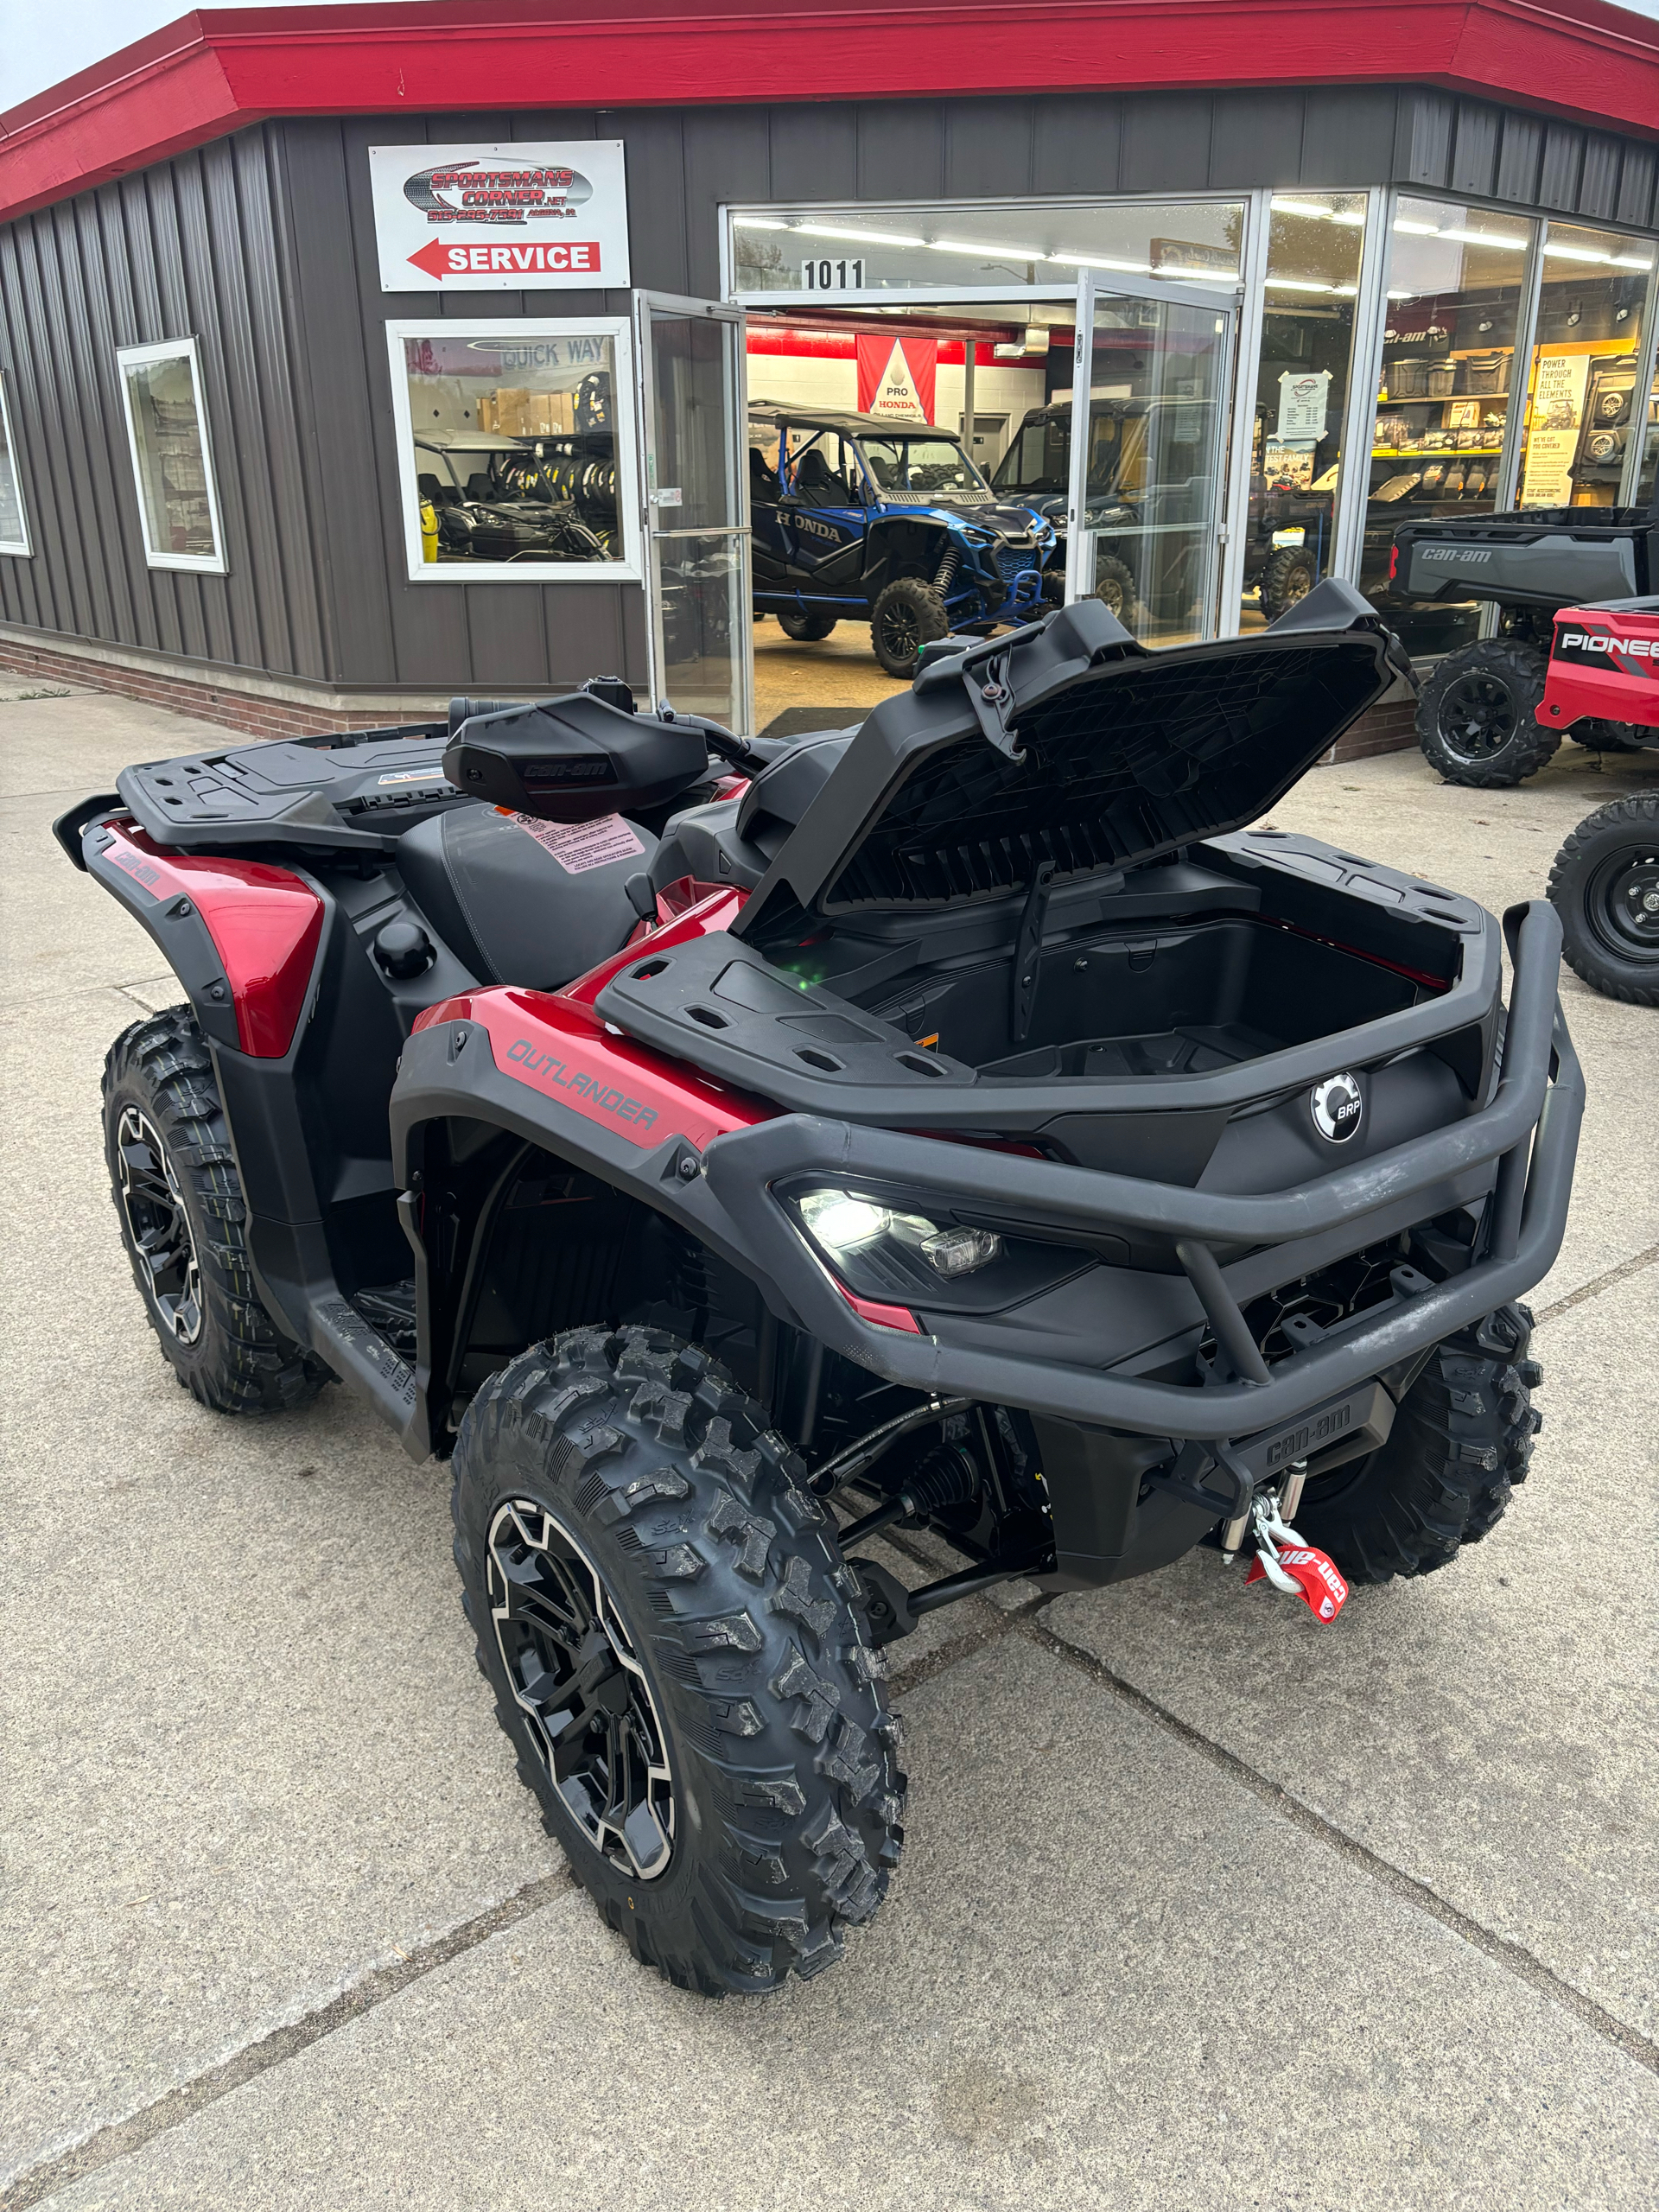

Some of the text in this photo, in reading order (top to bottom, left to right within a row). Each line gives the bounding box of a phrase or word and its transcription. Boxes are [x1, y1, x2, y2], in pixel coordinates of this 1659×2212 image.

[431, 170, 574, 189] SPORTSMANS
[427, 209, 524, 222] 515-295-7591
[448, 246, 590, 270] SERVICE
[805, 260, 862, 289] 1011
[504, 337, 605, 371] QUICK WAY
[1541, 369, 1572, 378] THROUGH
[1542, 359, 1566, 369] POWER
[887, 387, 908, 396] PRO
[1540, 379, 1565, 389] ALL THE
[1539, 390, 1572, 399] ELEMENTS
[775, 511, 842, 543] HONDA
[1421, 547, 1492, 563] can-am
[524, 761, 608, 778] can-am
[114, 851, 161, 887] can-am
[506, 1039, 659, 1130] OUTLANDER
[1337, 1100, 1360, 1120] BRP
[1266, 1403, 1351, 1467] can-am
